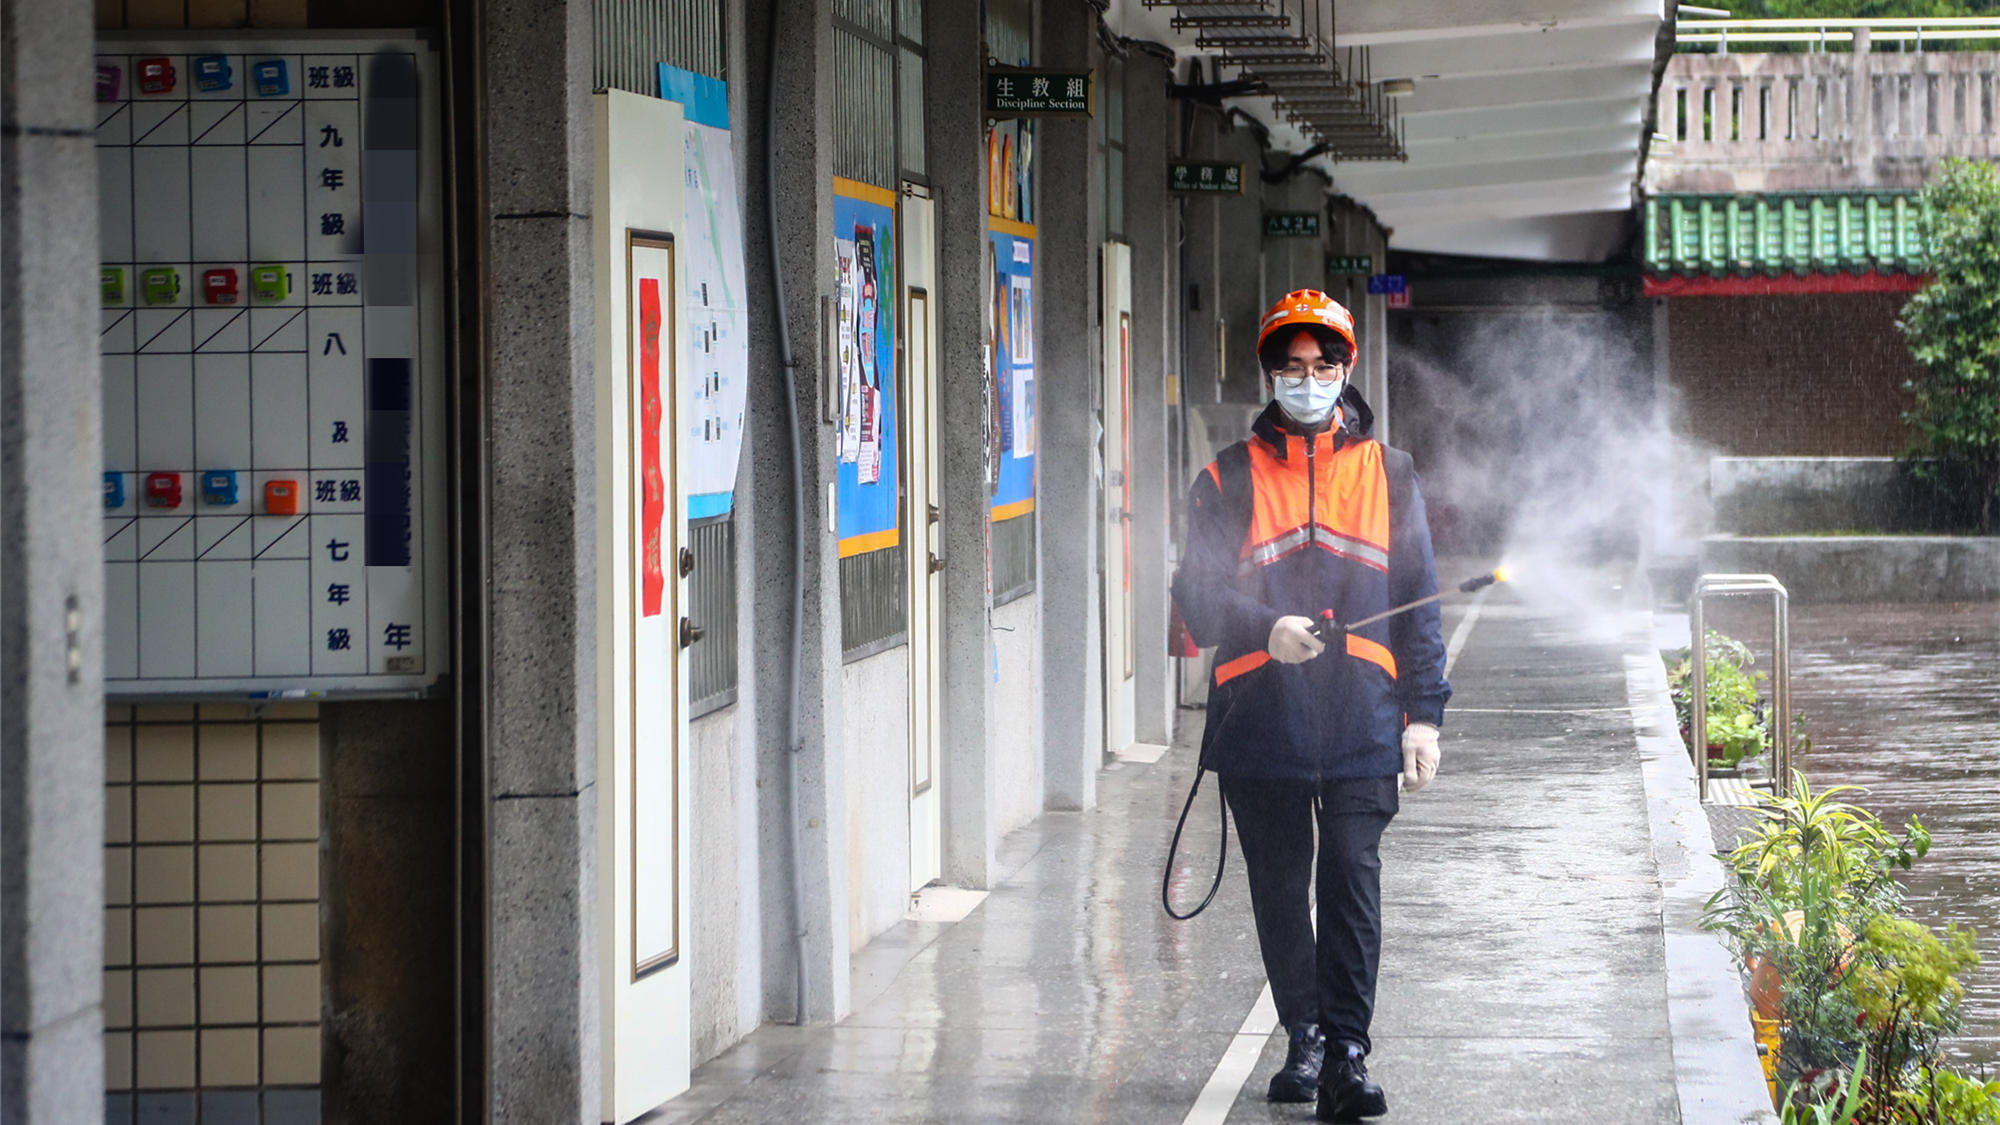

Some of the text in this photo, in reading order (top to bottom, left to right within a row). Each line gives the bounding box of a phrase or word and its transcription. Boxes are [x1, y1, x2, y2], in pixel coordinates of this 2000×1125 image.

[308, 66, 354, 89] 班級
[996, 77, 1084, 97] 生教組
[996, 98, 1085, 110] Discipline Section
[311, 273, 357, 295] 班級
[315, 480, 361, 503] 班級
